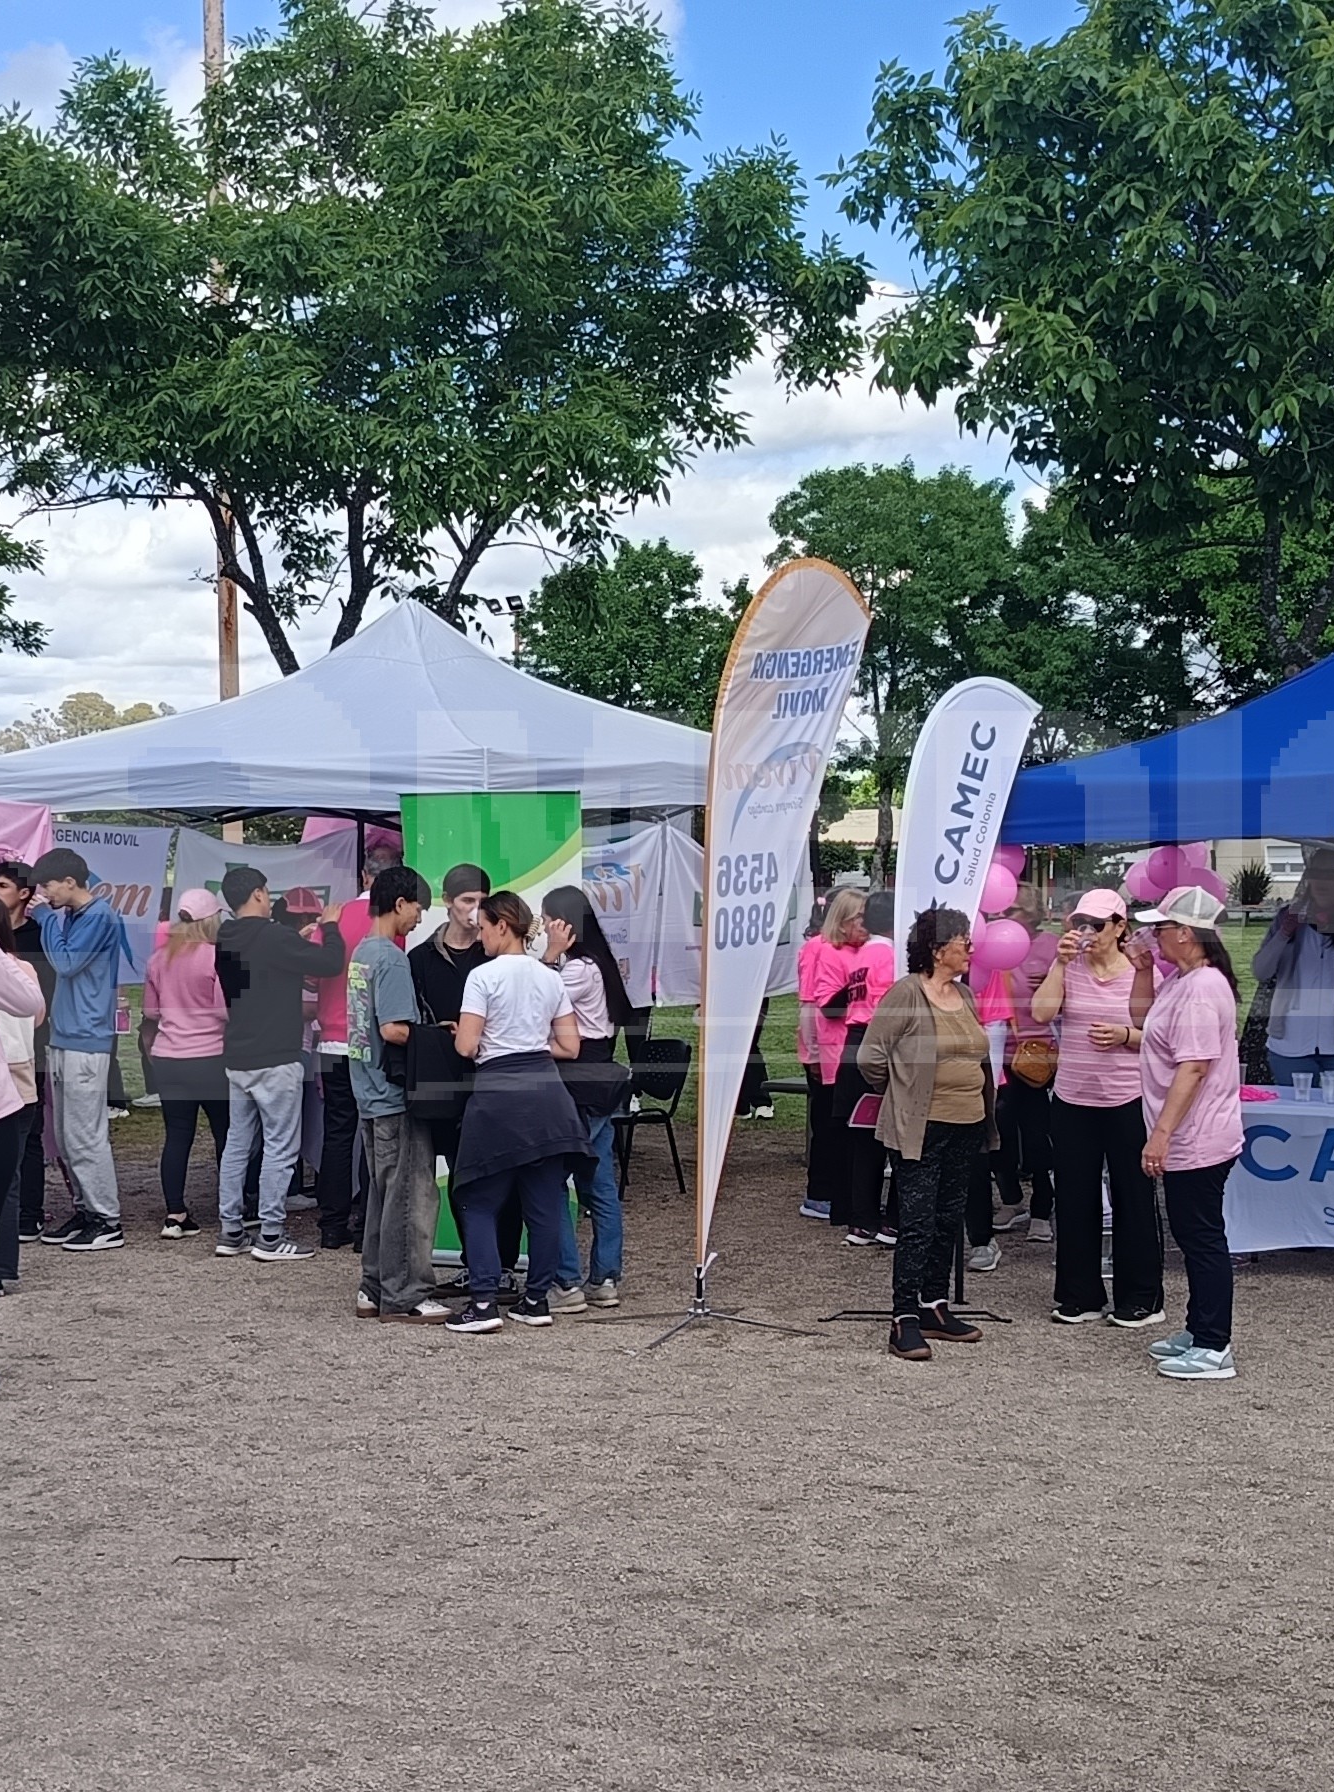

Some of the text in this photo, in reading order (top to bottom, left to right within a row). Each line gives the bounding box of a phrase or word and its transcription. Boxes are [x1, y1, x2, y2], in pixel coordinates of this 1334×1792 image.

[53, 828, 140, 847] GENCIA MOVIL
[934, 720, 997, 885] CAMEC
[963, 792, 997, 886] Salud Colonia
